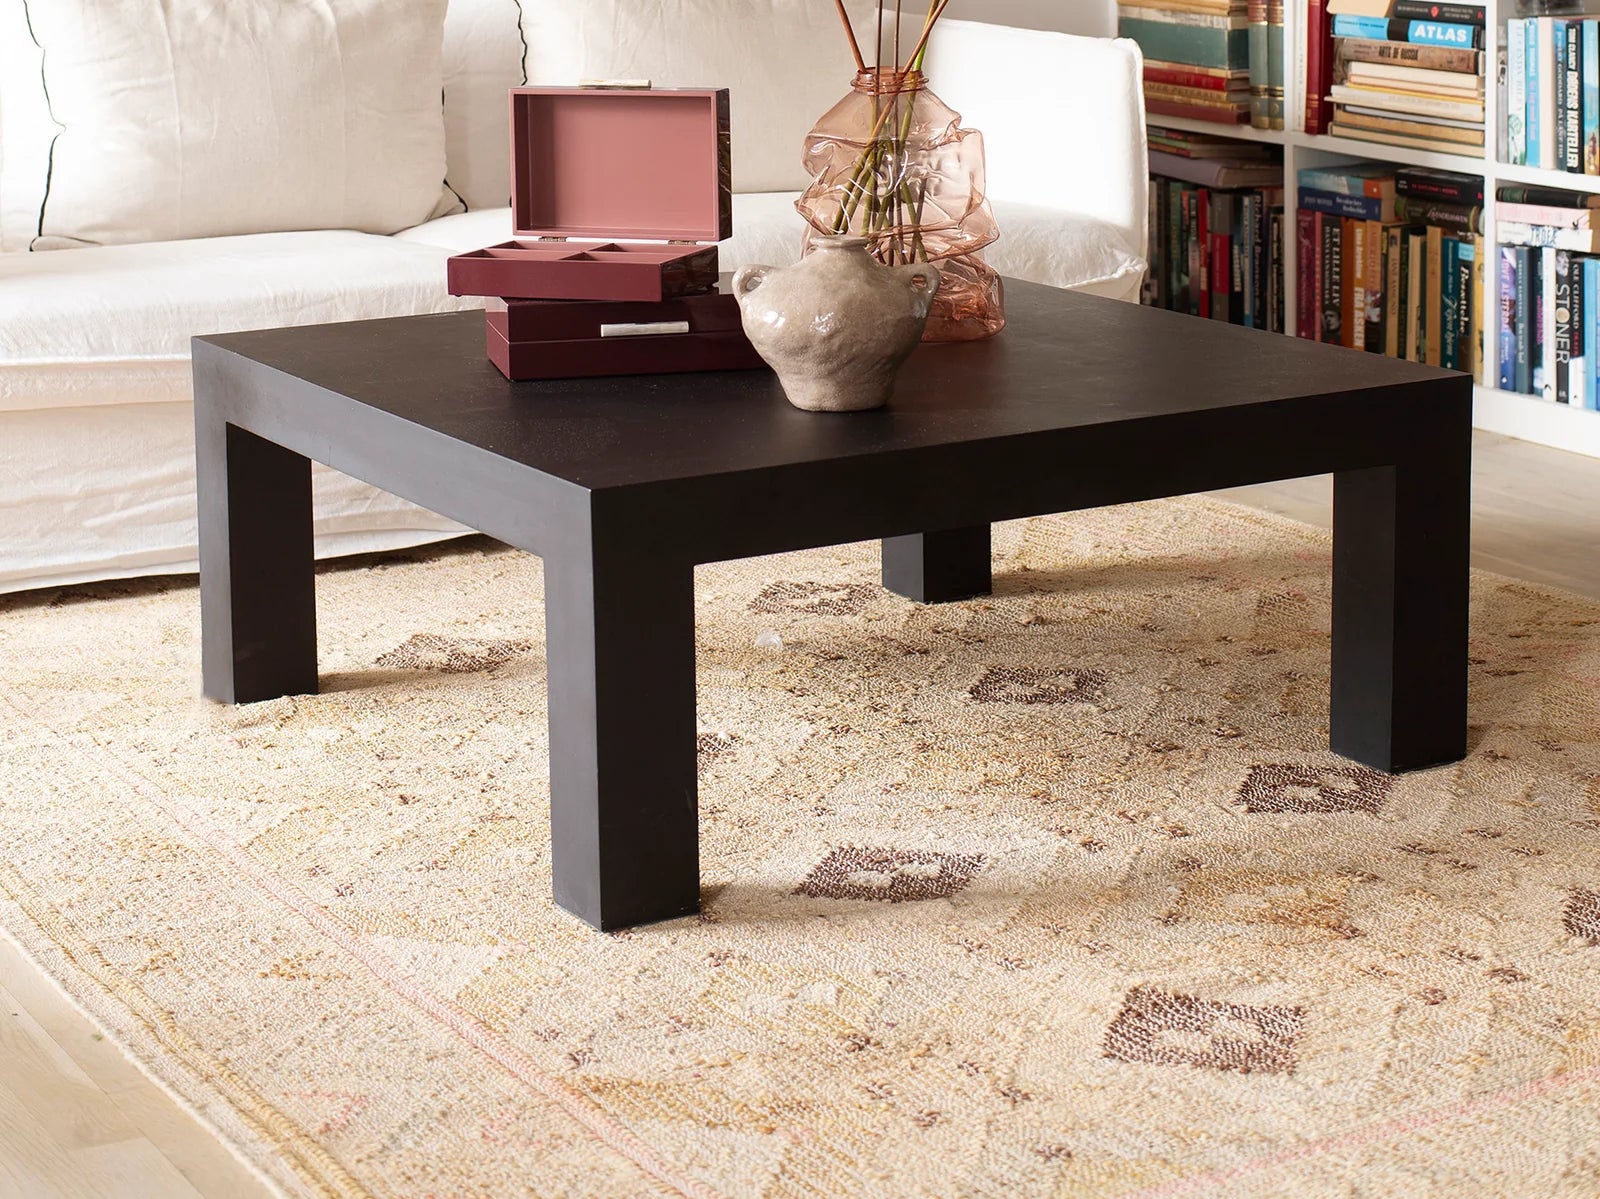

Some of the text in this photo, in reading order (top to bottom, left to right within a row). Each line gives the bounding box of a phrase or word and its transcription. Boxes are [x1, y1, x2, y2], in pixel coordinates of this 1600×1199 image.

[1414, 24, 1467, 43] ATLAS
[1566, 110, 1579, 168] KARTELLER
[1332, 227, 1341, 307] ET LILLE LIV
[1354, 287, 1365, 308] FRA
[1459, 265, 1470, 334] Besættelse
[1572, 264, 1580, 330] OLE CLIFFORD
[1556, 283, 1570, 364] STONER
